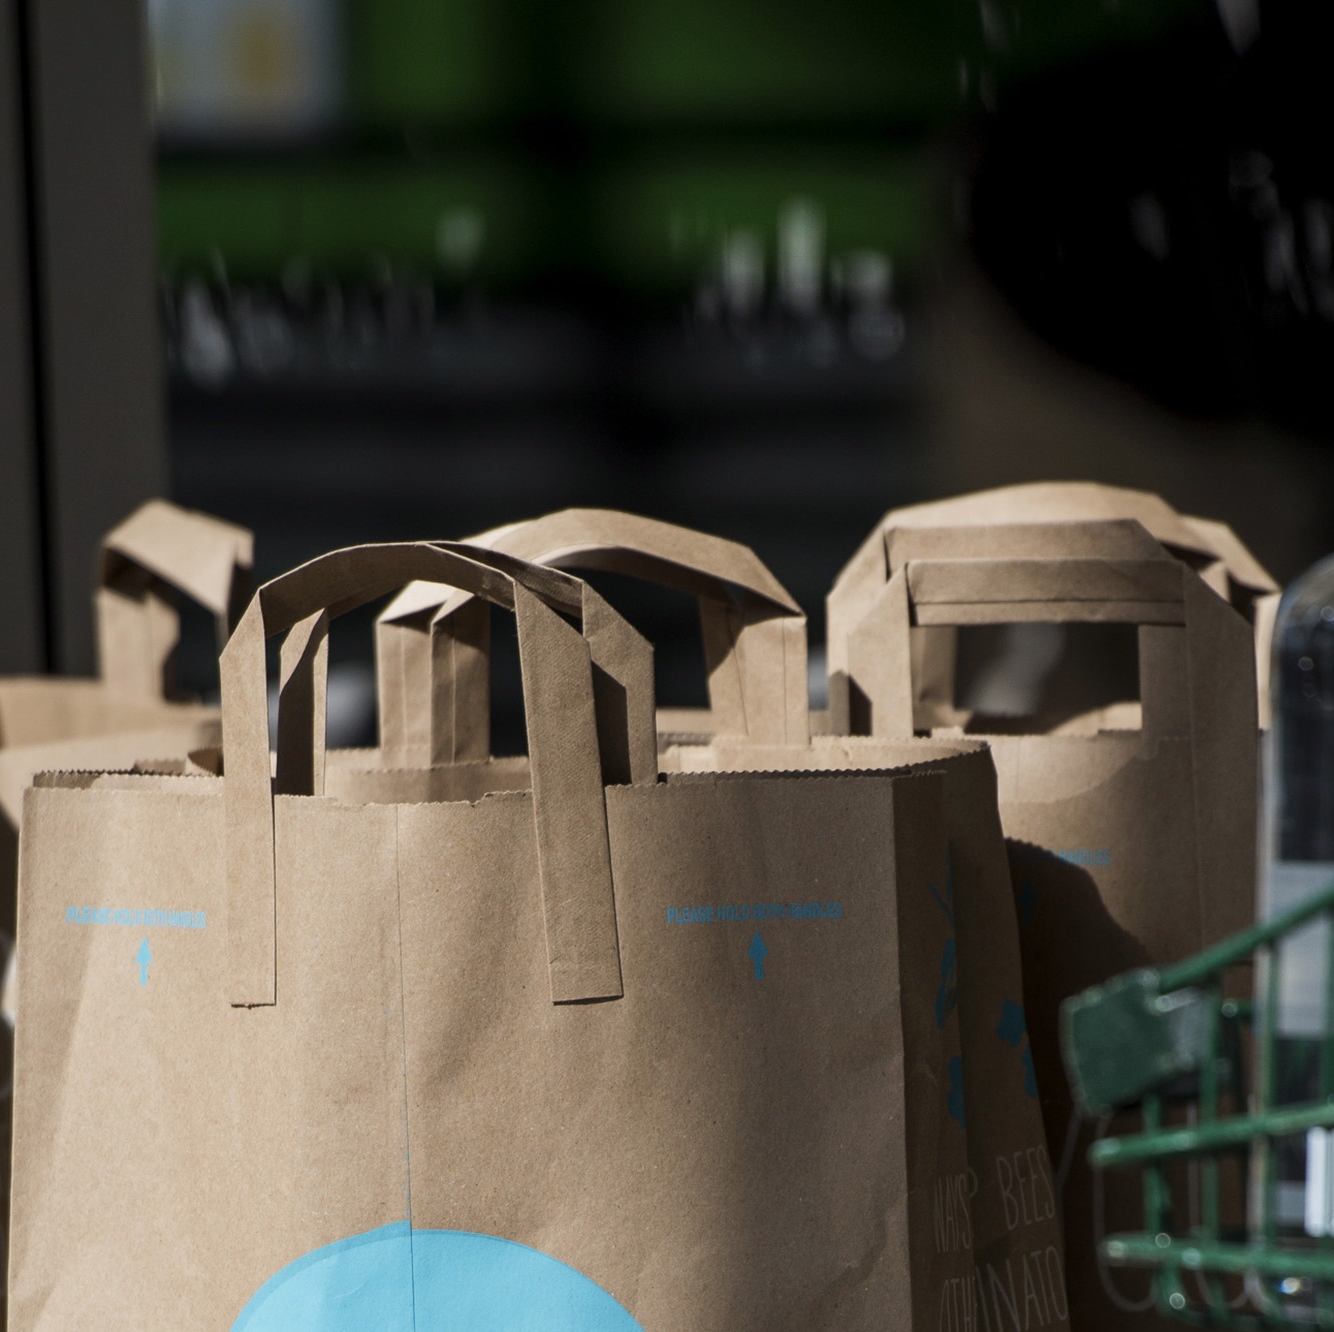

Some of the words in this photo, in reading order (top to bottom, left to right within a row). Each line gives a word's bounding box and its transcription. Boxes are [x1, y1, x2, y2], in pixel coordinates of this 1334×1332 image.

[667, 906, 714, 923] PLEASE
[717, 904, 749, 921] HOLD
[996, 1143, 1056, 1231] BEES
